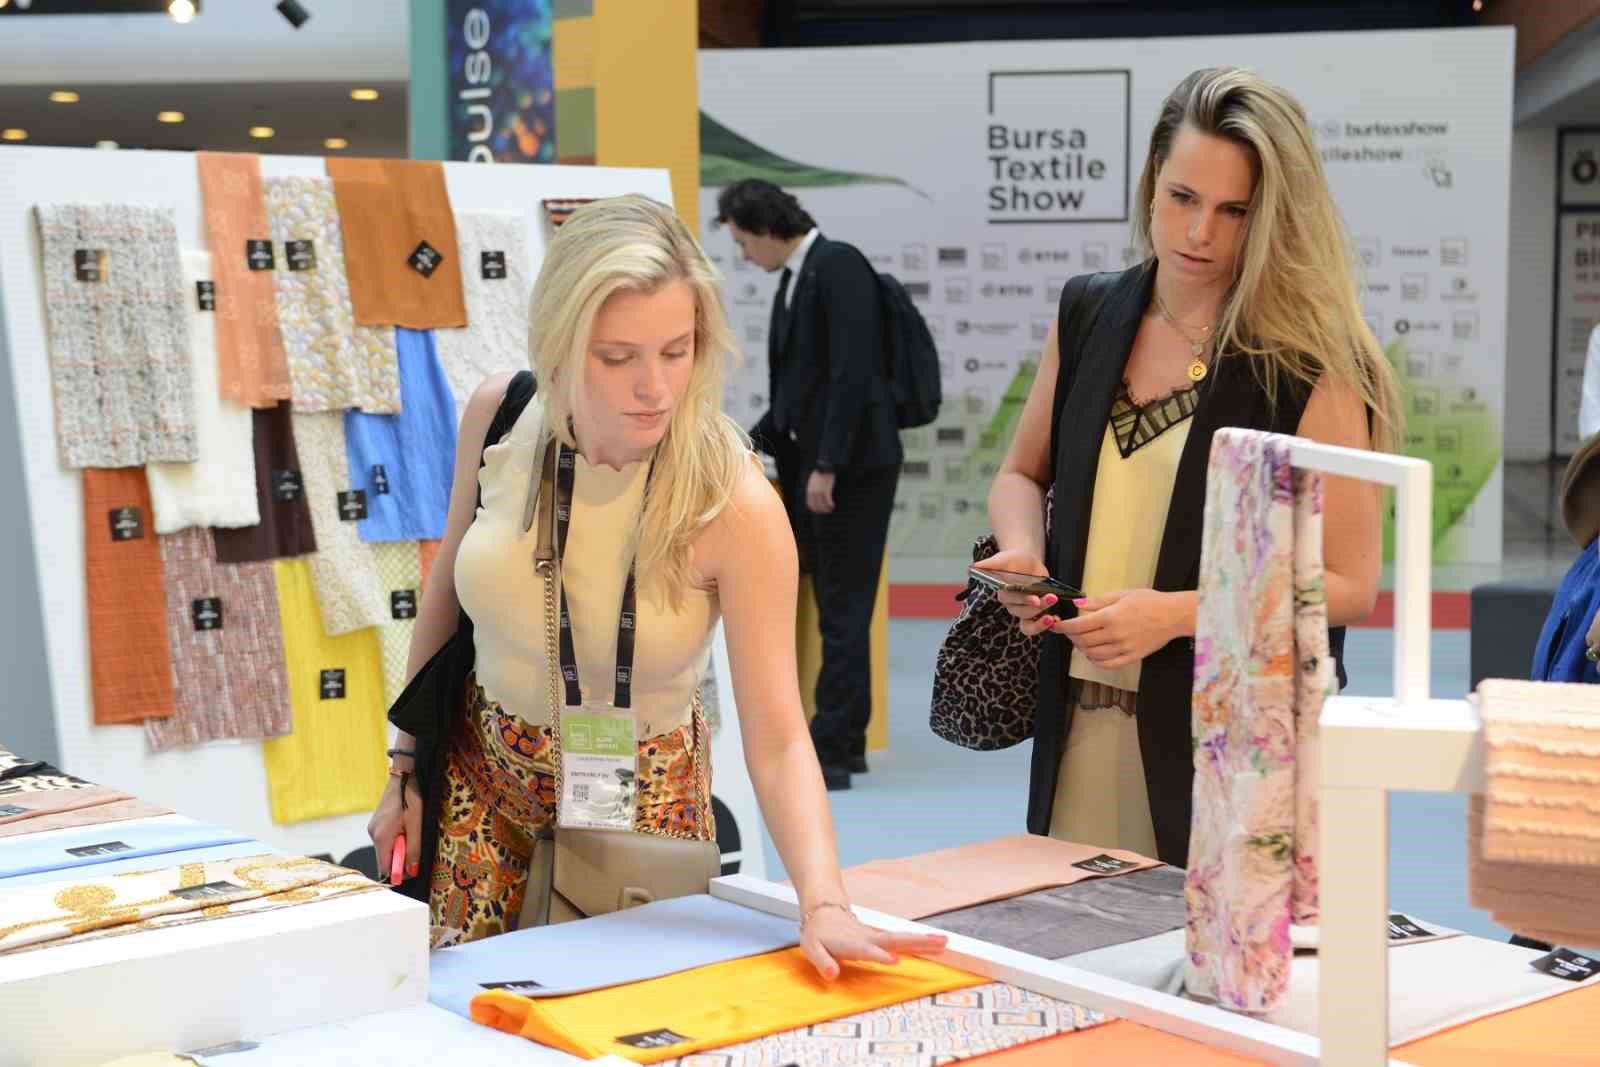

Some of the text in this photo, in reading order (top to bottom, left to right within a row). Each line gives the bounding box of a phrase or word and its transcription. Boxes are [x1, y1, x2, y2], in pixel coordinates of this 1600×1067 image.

[987, 125, 1087, 151] Bursa
[987, 152, 1107, 181] Textile
[987, 184, 1084, 211] Show
